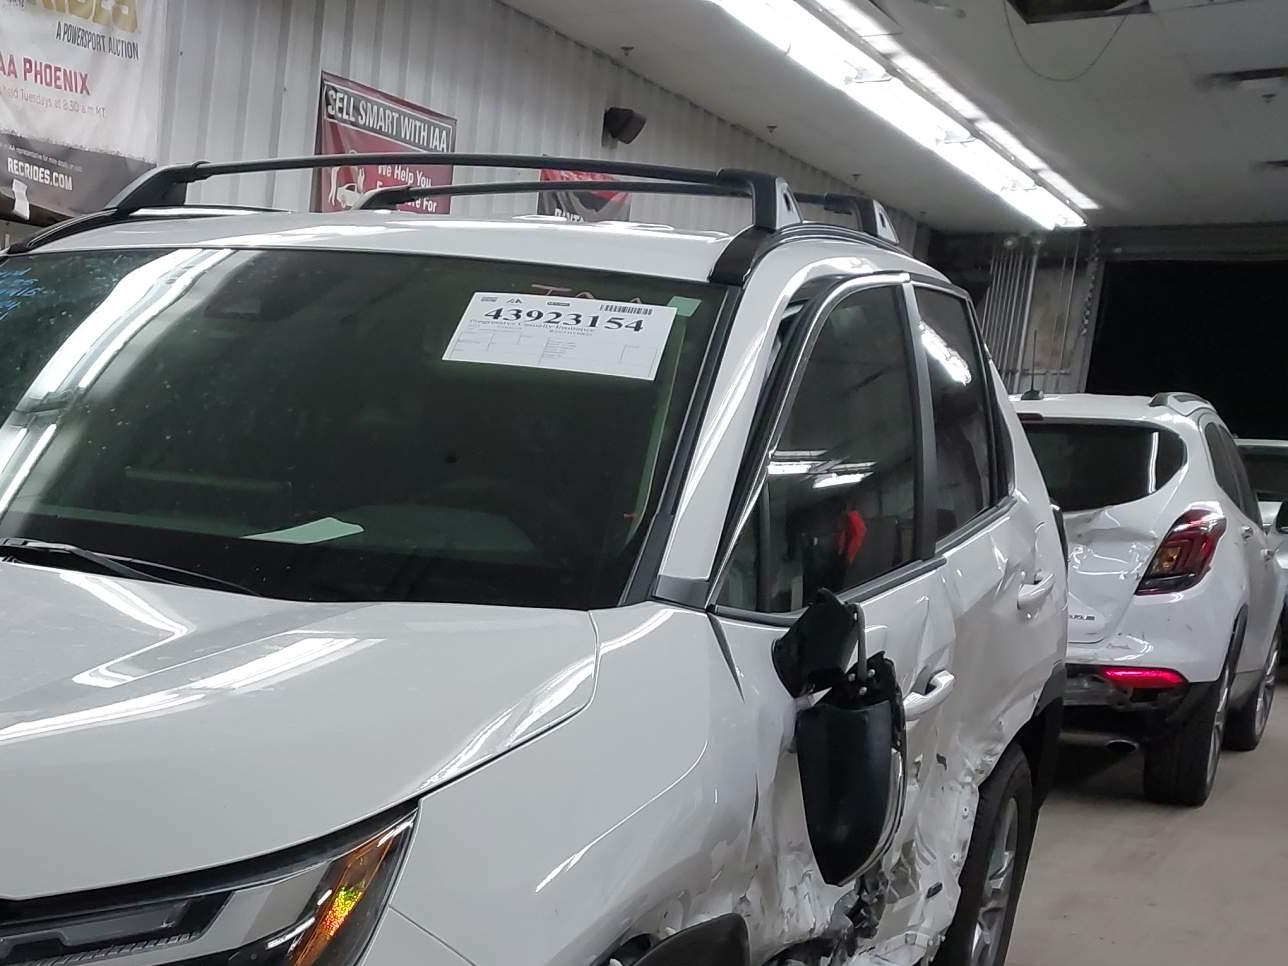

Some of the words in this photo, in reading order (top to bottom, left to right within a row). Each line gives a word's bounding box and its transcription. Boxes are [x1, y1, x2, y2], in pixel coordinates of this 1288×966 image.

[56, 21, 62, 41] A
[62, 22, 106, 53] POWERSPORT
[108, 36, 139, 60] AUCTION
[23, 57, 90, 96] PHOENIX
[21, 88, 52, 108] Tuesdays
[328, 90, 355, 122] SELL
[358, 100, 399, 136] SMART
[401, 115, 428, 146] WITH
[429, 126, 447, 153] IAA
[7, 157, 73, 191] RECRIDES.COM
[394, 165, 414, 186] Help
[416, 170, 432, 188] You
[423, 197, 437, 213] For
[484, 307, 644, 333] 43923154
